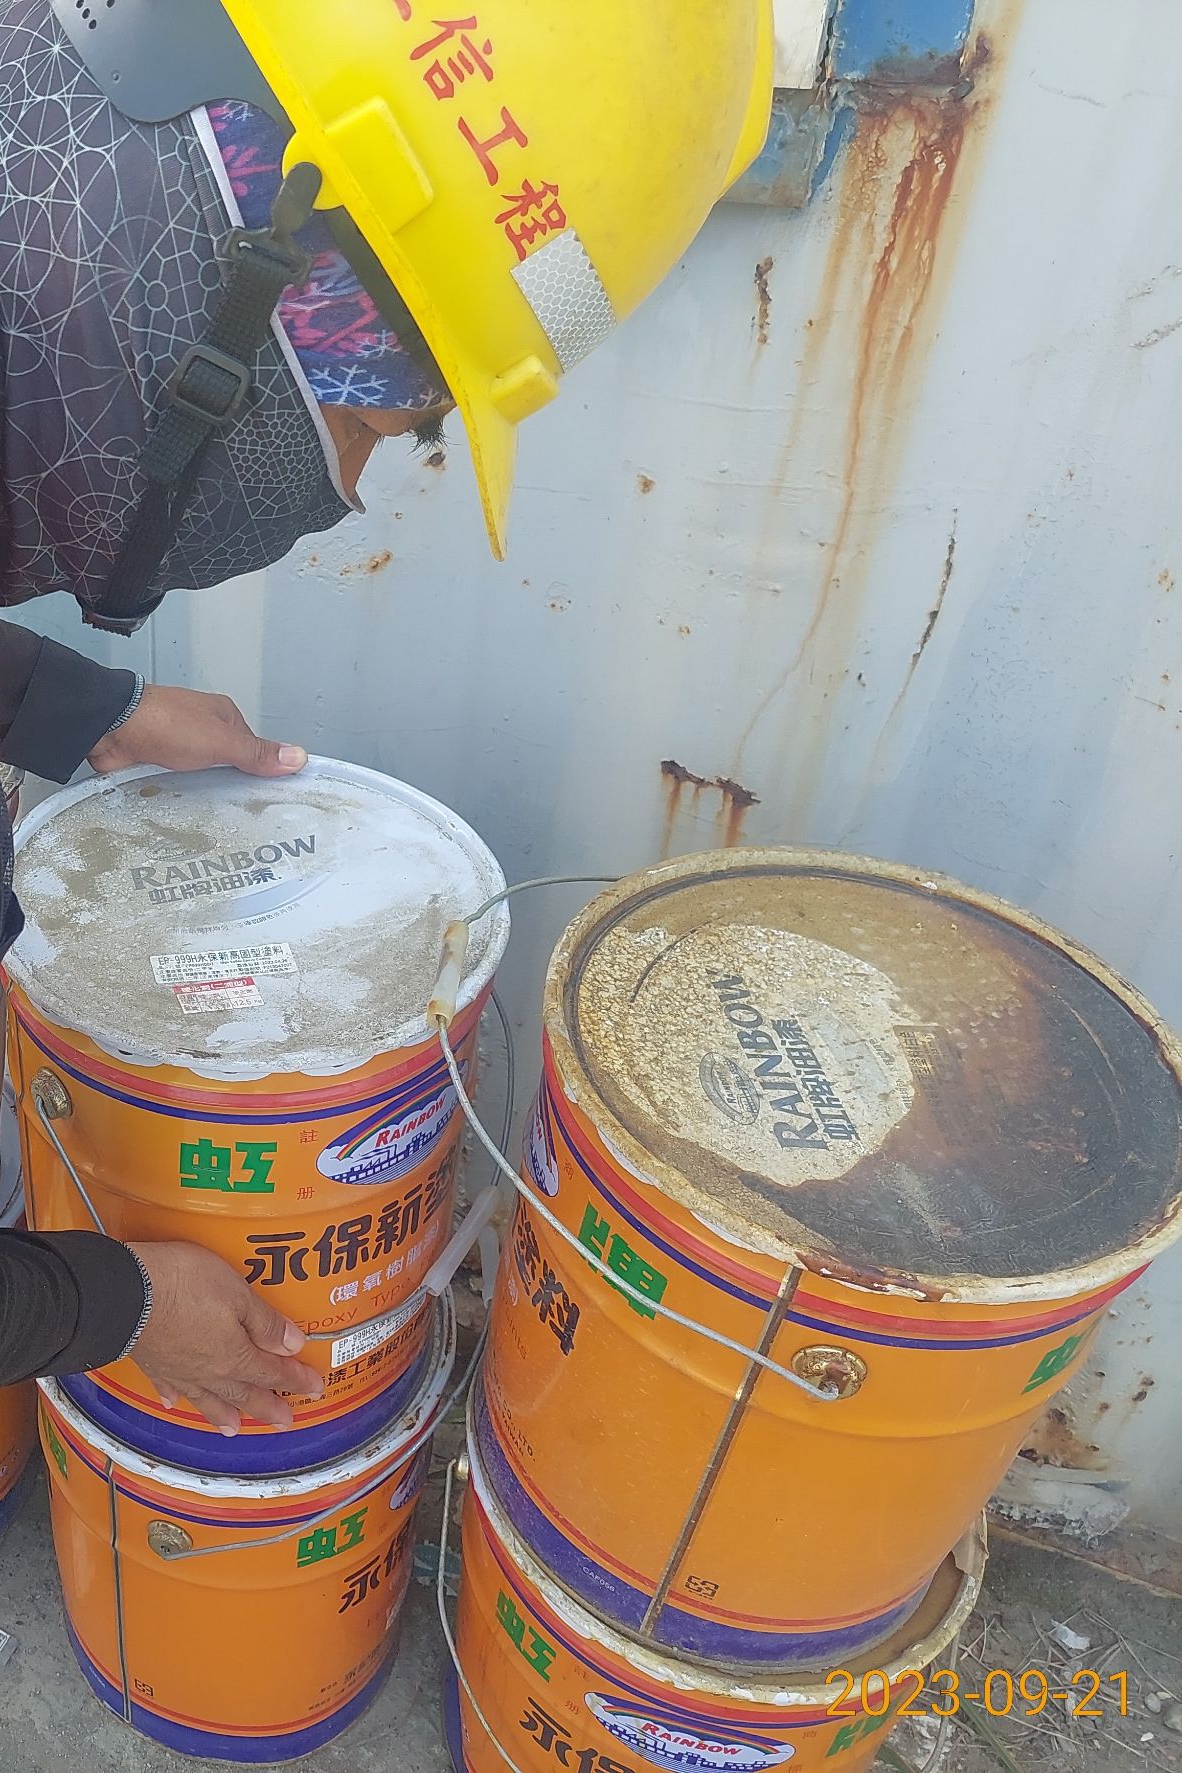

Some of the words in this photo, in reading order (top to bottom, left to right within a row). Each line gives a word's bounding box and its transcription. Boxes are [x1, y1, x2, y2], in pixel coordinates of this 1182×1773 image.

[392, 0, 567, 262] 信工程
[130, 834, 316, 891] RAINBOW
[148, 867, 276, 906] 虹牌油漆
[705, 969, 830, 1150] RAINBOW
[375, 1093, 447, 1149] RAINBOW
[179, 1138, 278, 1194] 虹
[297, 1506, 368, 1568] 虹
[495, 1588, 557, 1684] 虹
[640, 1721, 743, 1757] RAINBOW
